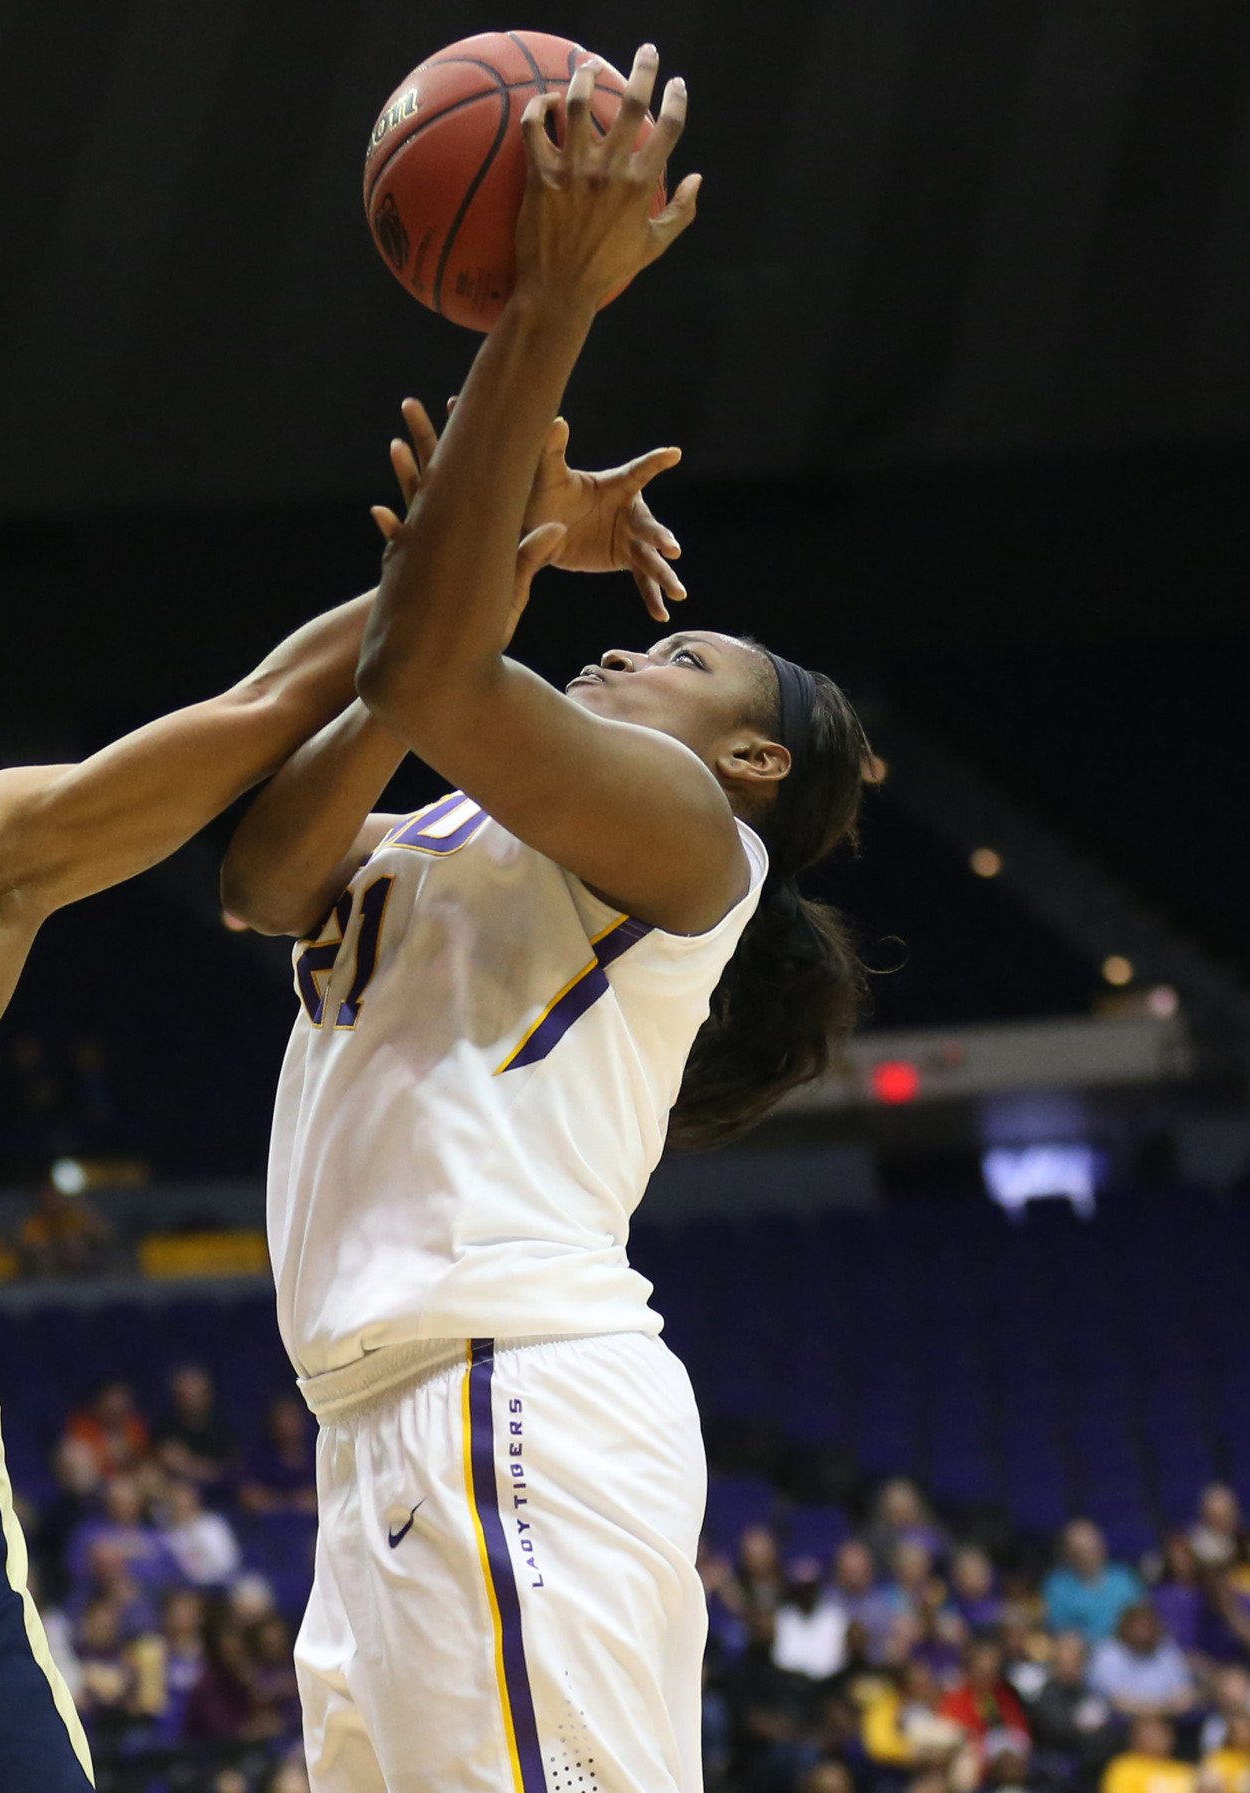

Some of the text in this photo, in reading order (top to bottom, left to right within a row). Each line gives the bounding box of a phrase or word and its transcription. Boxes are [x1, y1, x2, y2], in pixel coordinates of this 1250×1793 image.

[296, 874, 396, 1030] 21
[509, 1398, 544, 1588] LADY TIGERS
